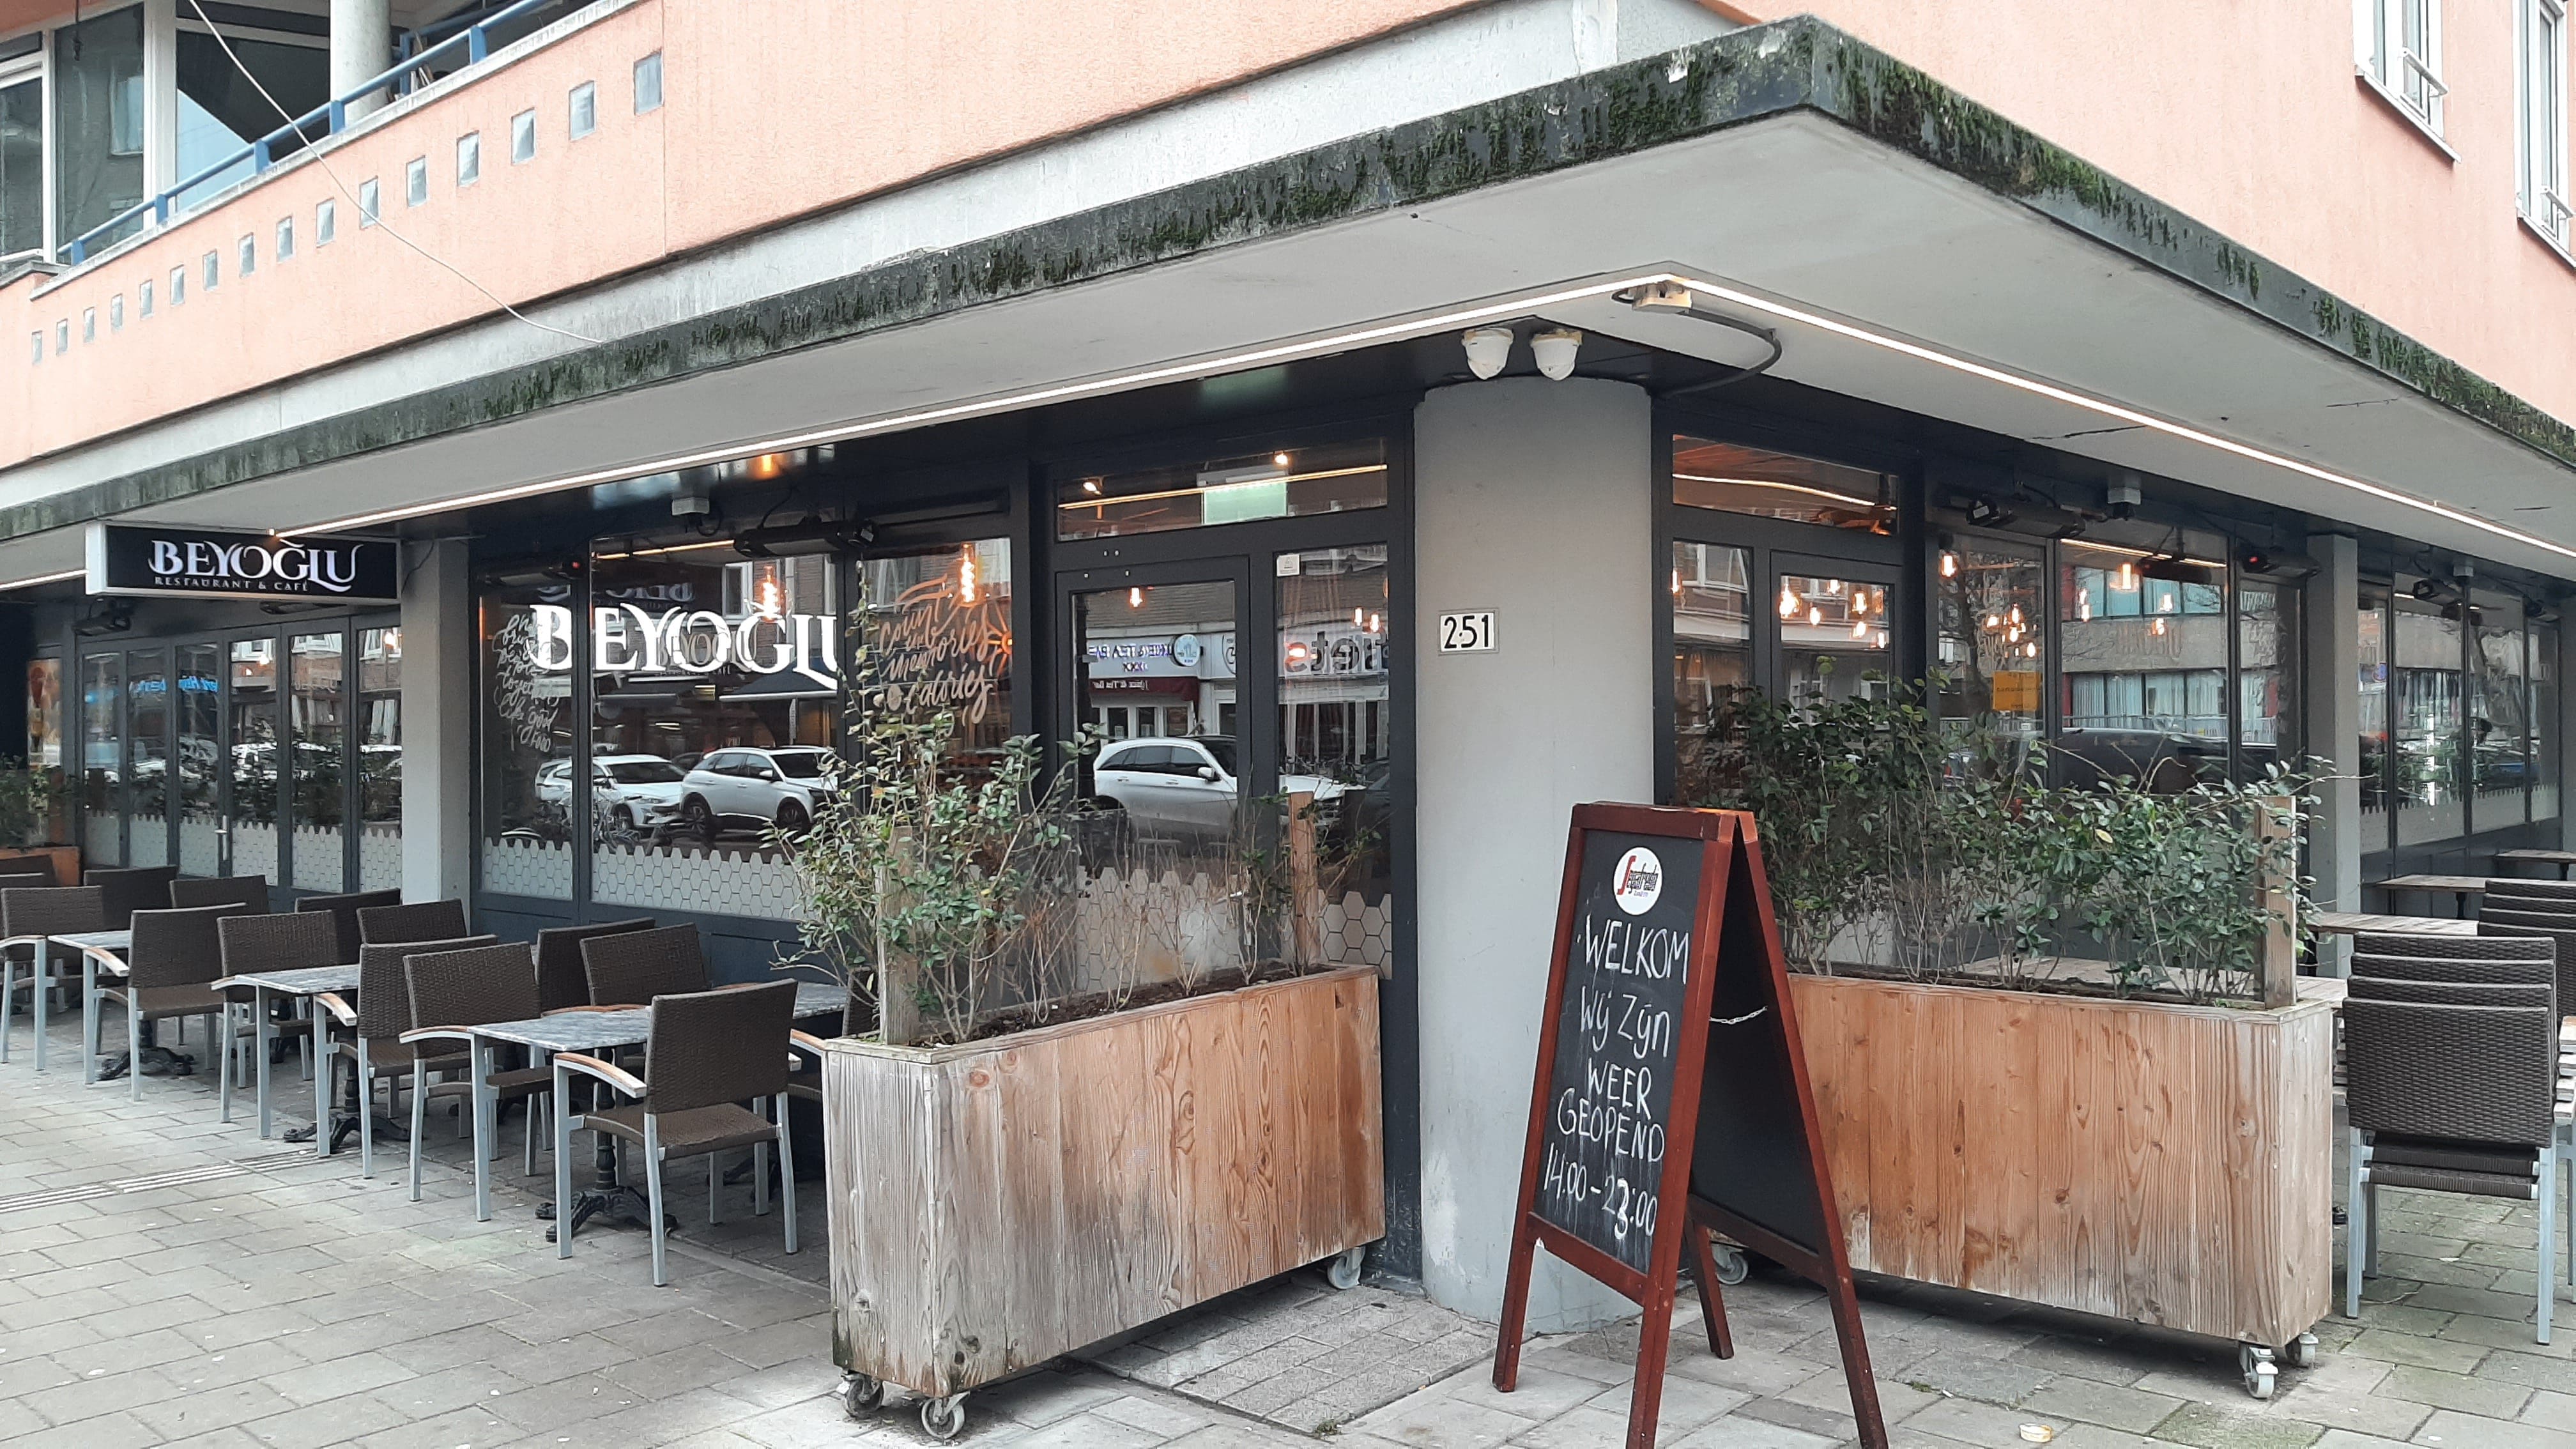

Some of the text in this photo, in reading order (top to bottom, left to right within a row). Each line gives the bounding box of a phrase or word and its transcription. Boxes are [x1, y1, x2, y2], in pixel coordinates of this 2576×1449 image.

[148, 539, 364, 592] BEYOĞLU
[155, 576, 250, 589] RESTAURANT
[258, 581, 266, 590] &
[1444, 615, 1489, 648] 251
[1585, 914, 1689, 985] WELKOM
[1588, 1057, 1652, 1120] WEER
[1558, 1087, 1665, 1163] GEOPEND
